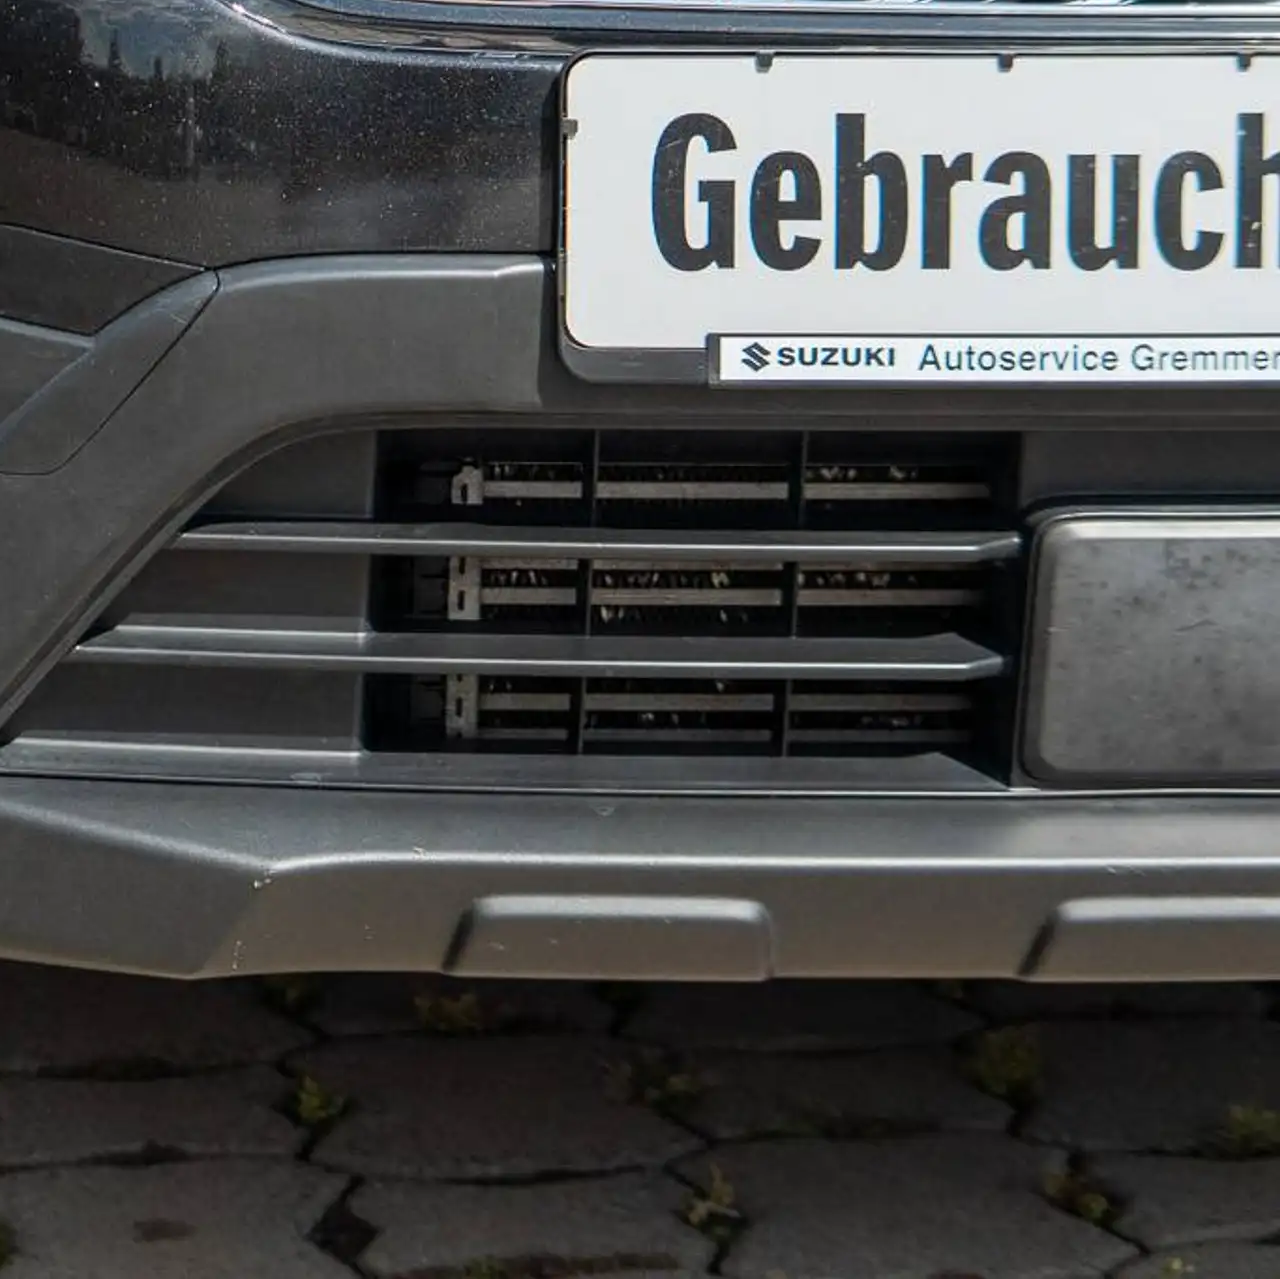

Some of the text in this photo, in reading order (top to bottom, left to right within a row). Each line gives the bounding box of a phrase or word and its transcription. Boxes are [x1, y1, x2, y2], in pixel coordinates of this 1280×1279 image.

[651, 112, 1280, 272] Gebrauch
[777, 347, 896, 367] SUZUKI
[918, 343, 1119, 372] Autoservice
